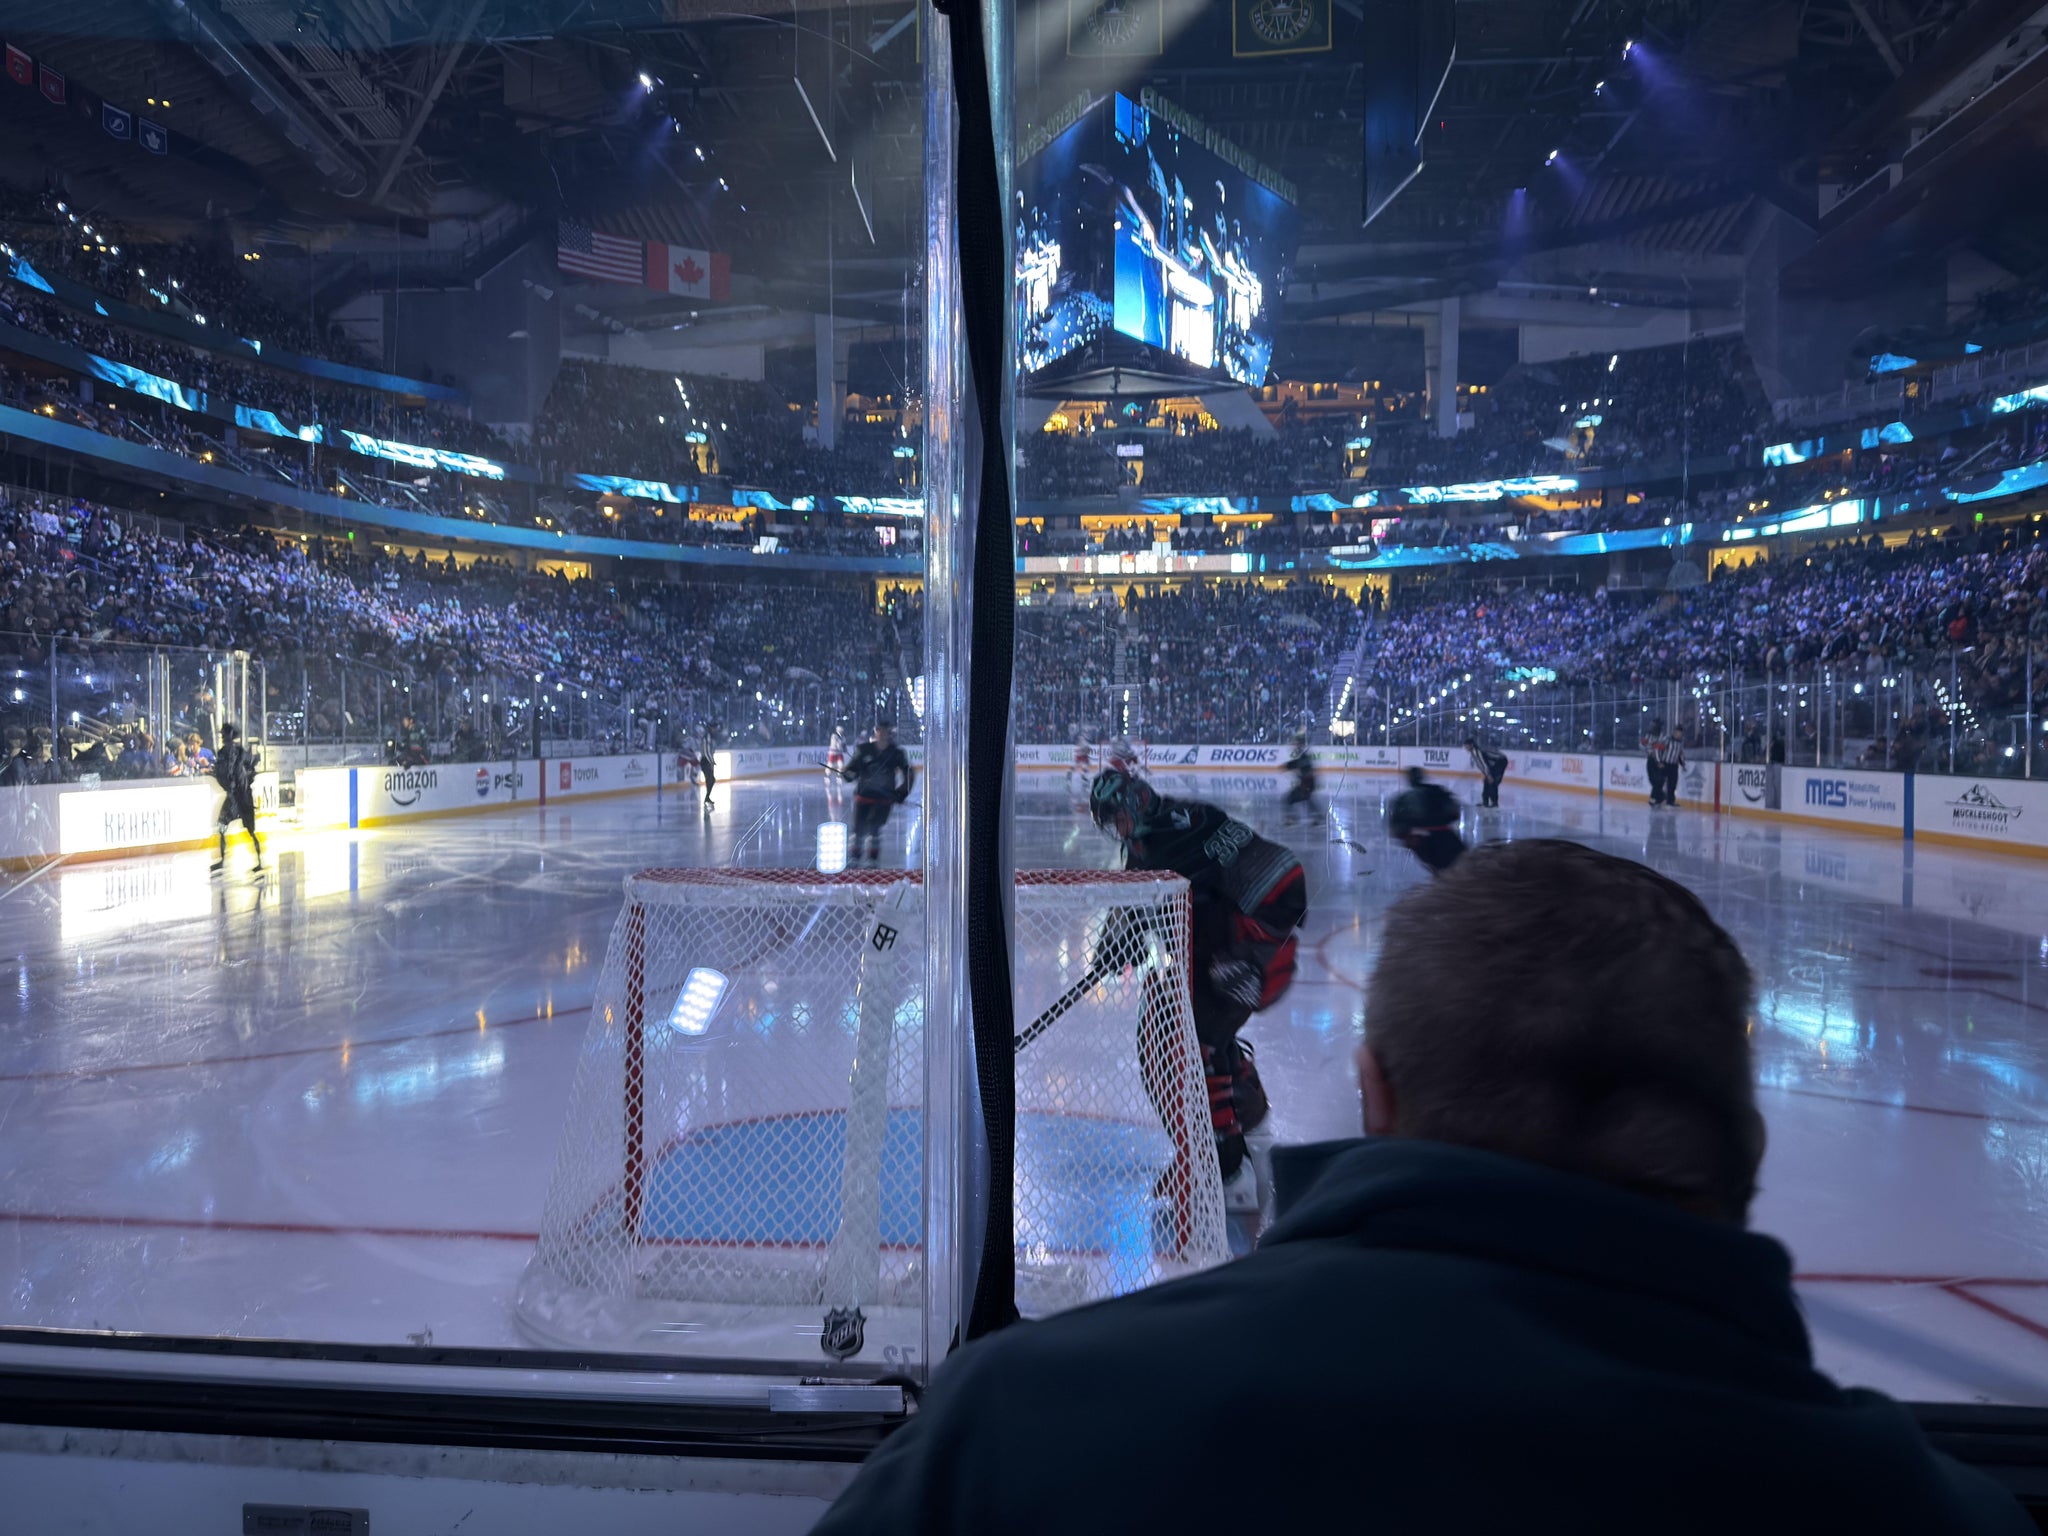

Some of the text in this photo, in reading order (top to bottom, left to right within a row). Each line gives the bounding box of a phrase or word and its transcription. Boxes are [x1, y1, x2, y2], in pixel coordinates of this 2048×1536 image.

[1210, 749, 1279, 762] BROOKS
[1424, 750, 1449, 762] TRULY
[384, 770, 438, 792] amazon
[574, 768, 598, 781] TOYOTA
[1738, 769, 1766, 787] amaz
[1806, 779, 1847, 807] MPS
[1953, 807, 2008, 824] MUCKLESHOOT
[1204, 819, 1253, 868] 35
